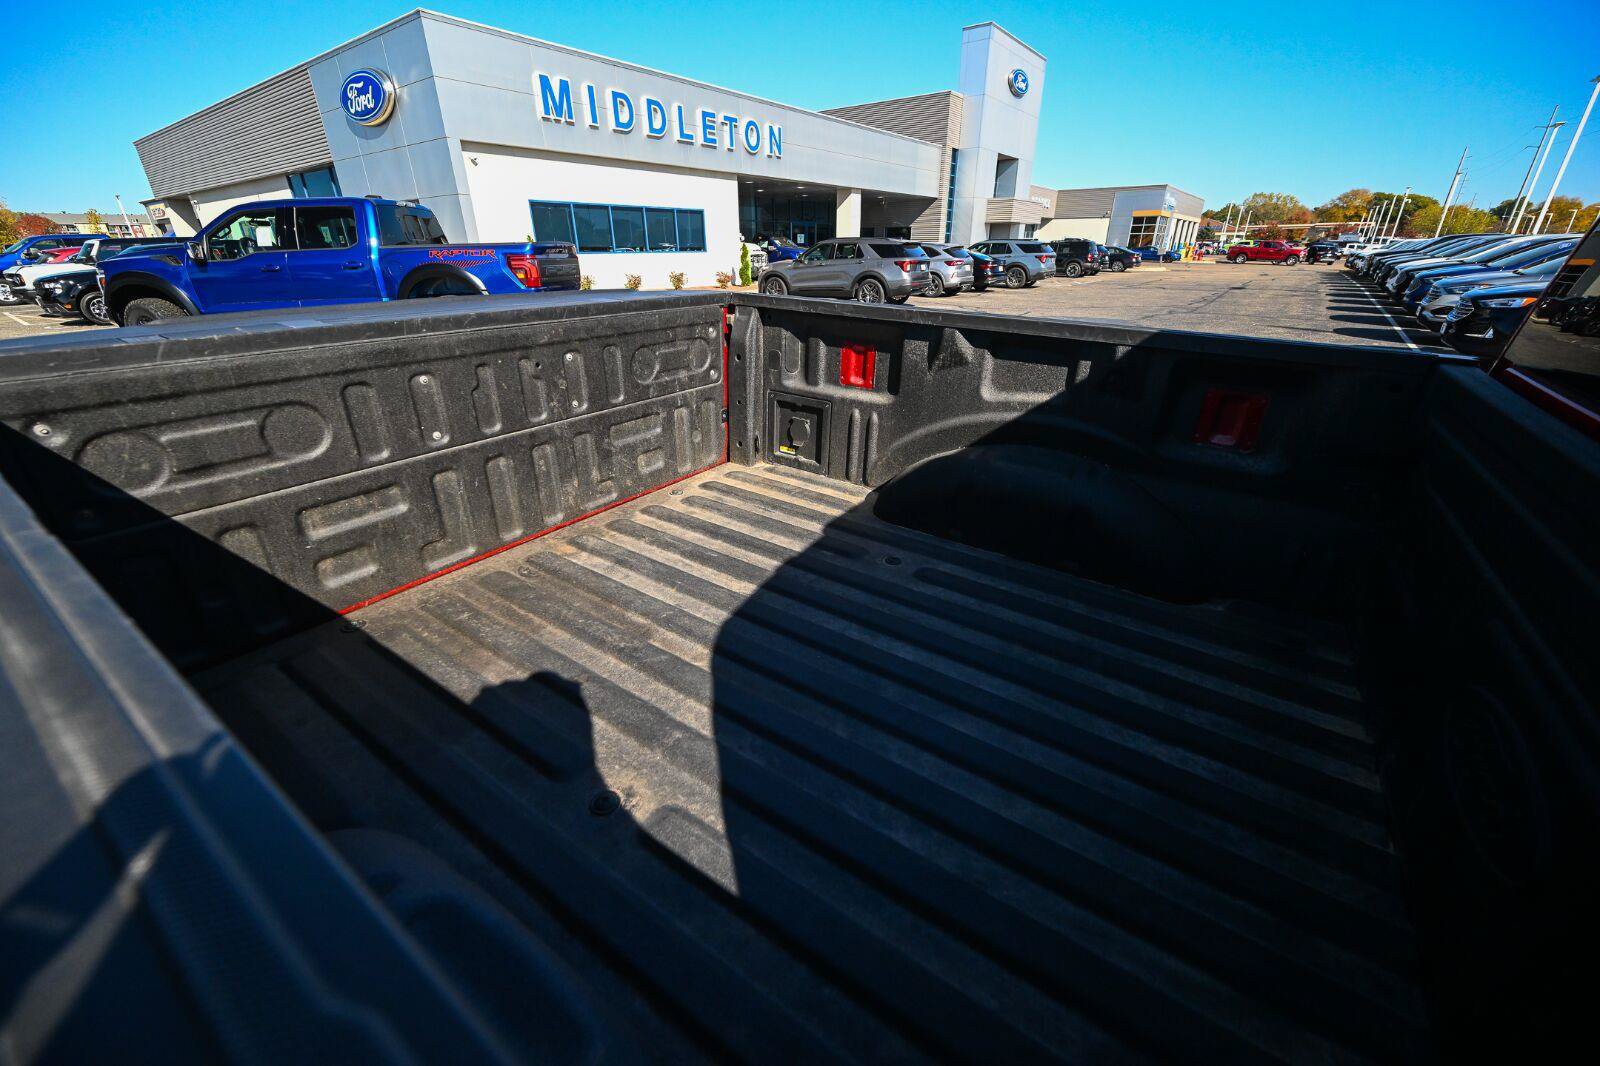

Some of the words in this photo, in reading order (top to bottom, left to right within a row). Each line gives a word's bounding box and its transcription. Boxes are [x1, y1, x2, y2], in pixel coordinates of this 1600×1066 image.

[347, 81, 374, 114] Ford
[535, 72, 783, 158] MIDDLETON
[428, 249, 498, 260] RAPTOR
